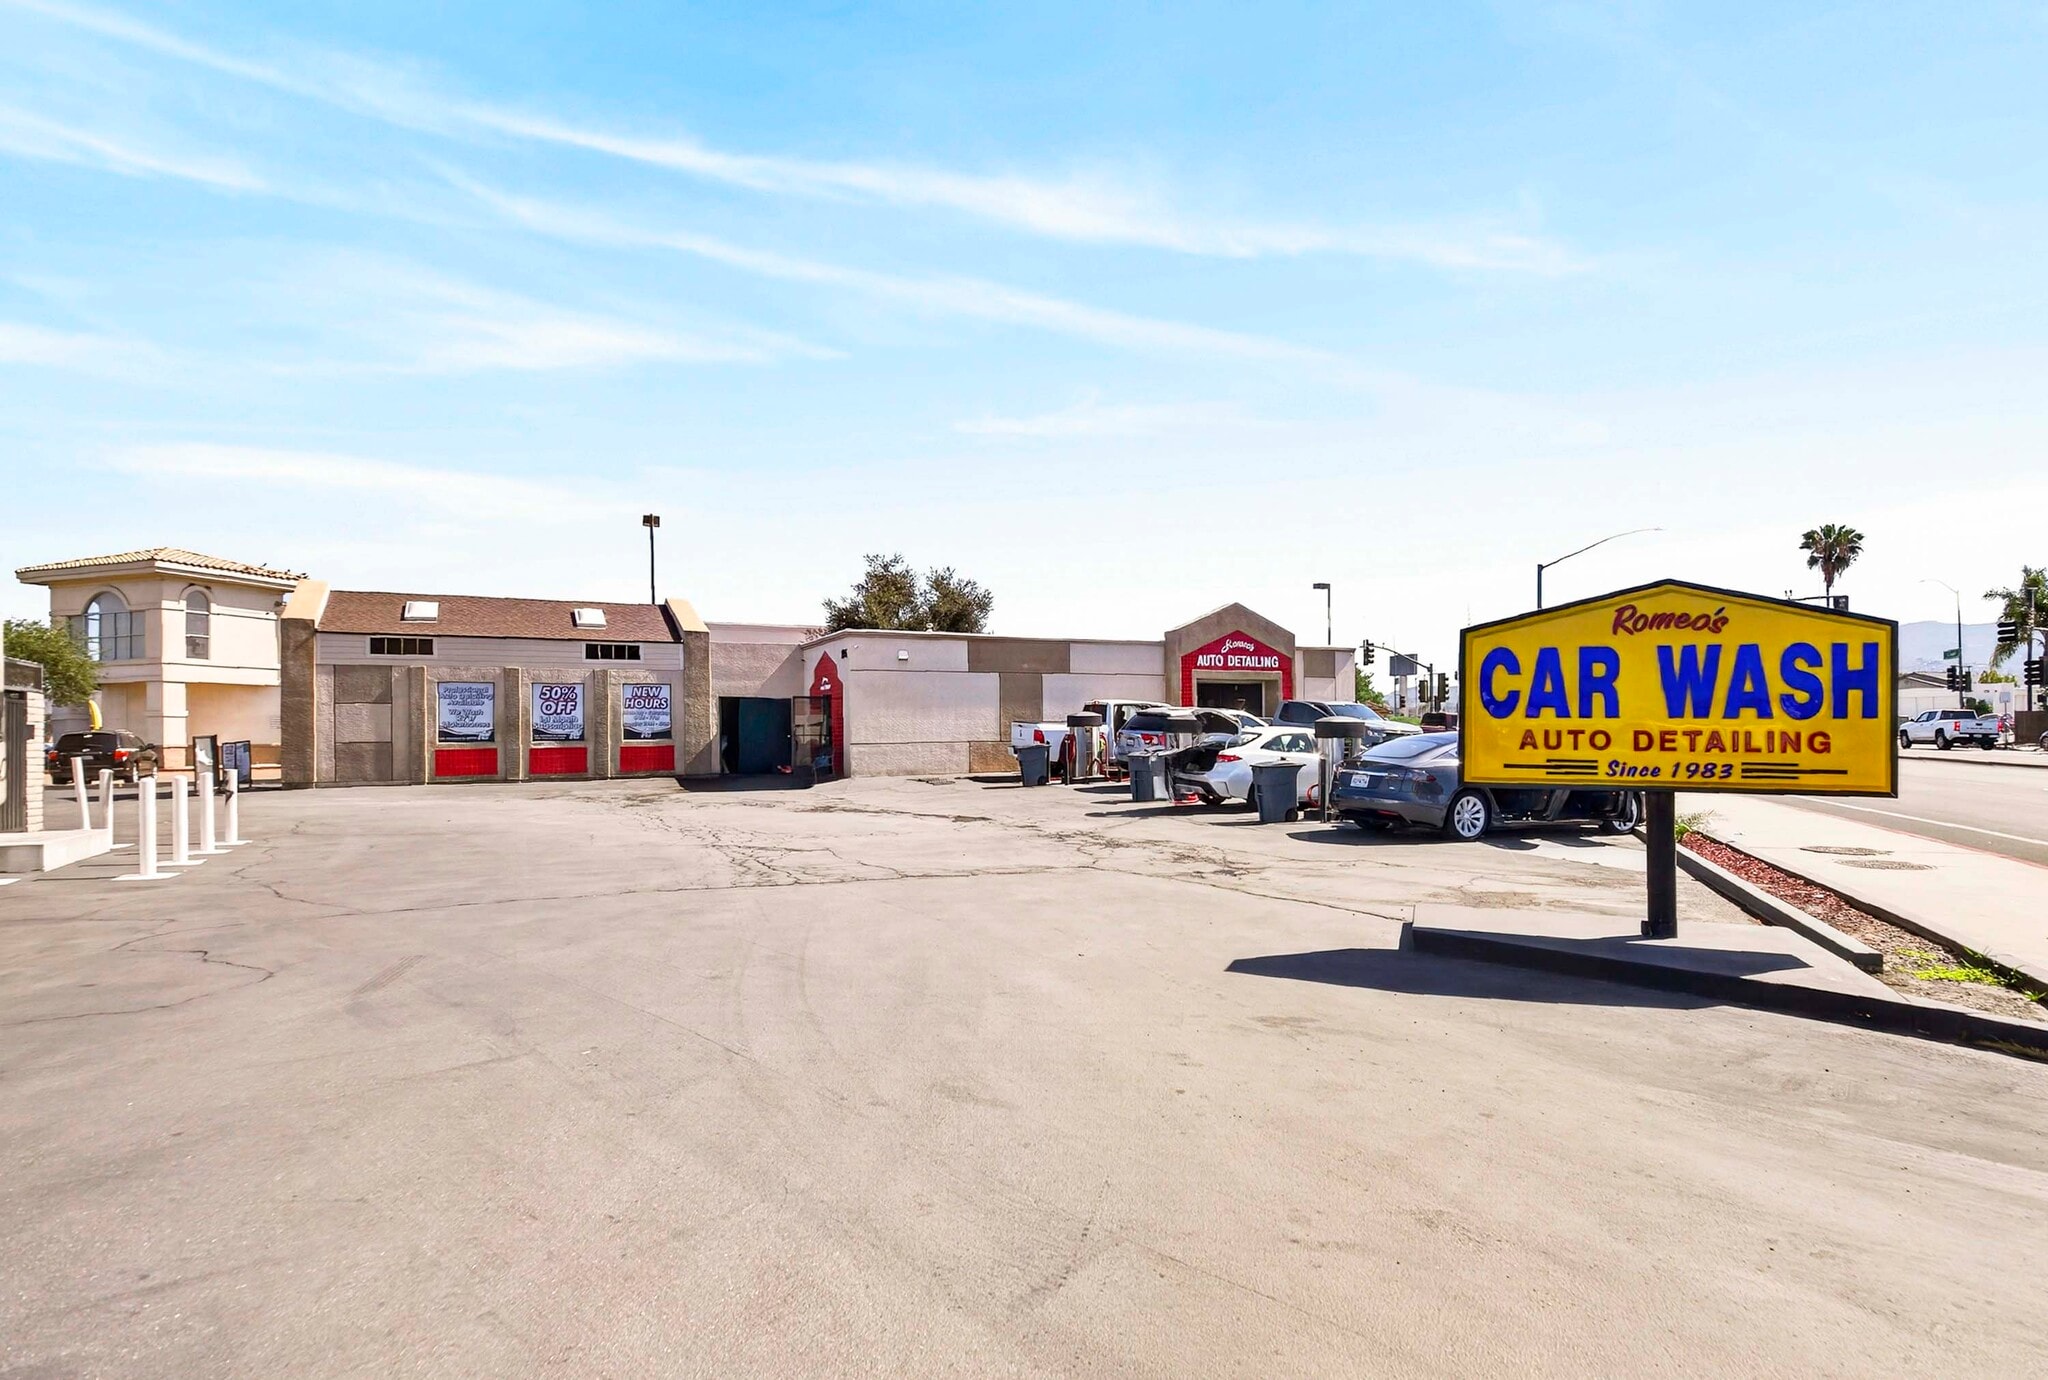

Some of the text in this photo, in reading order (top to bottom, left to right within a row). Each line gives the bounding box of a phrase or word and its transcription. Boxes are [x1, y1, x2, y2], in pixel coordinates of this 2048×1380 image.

[1612, 604, 1729, 636] Romeo's
[1197, 654, 1279, 668] AUTO DETAILING
[1479, 642, 1879, 720] CAR WASH
[539, 686, 577, 700] 50%
[632, 686, 662, 697] NEW
[540, 701, 577, 715] OFF
[624, 697, 669, 709] HOURS
[1519, 729, 1832, 754] AUTO DETAILING
[1605, 759, 1734, 780] Since 1983
